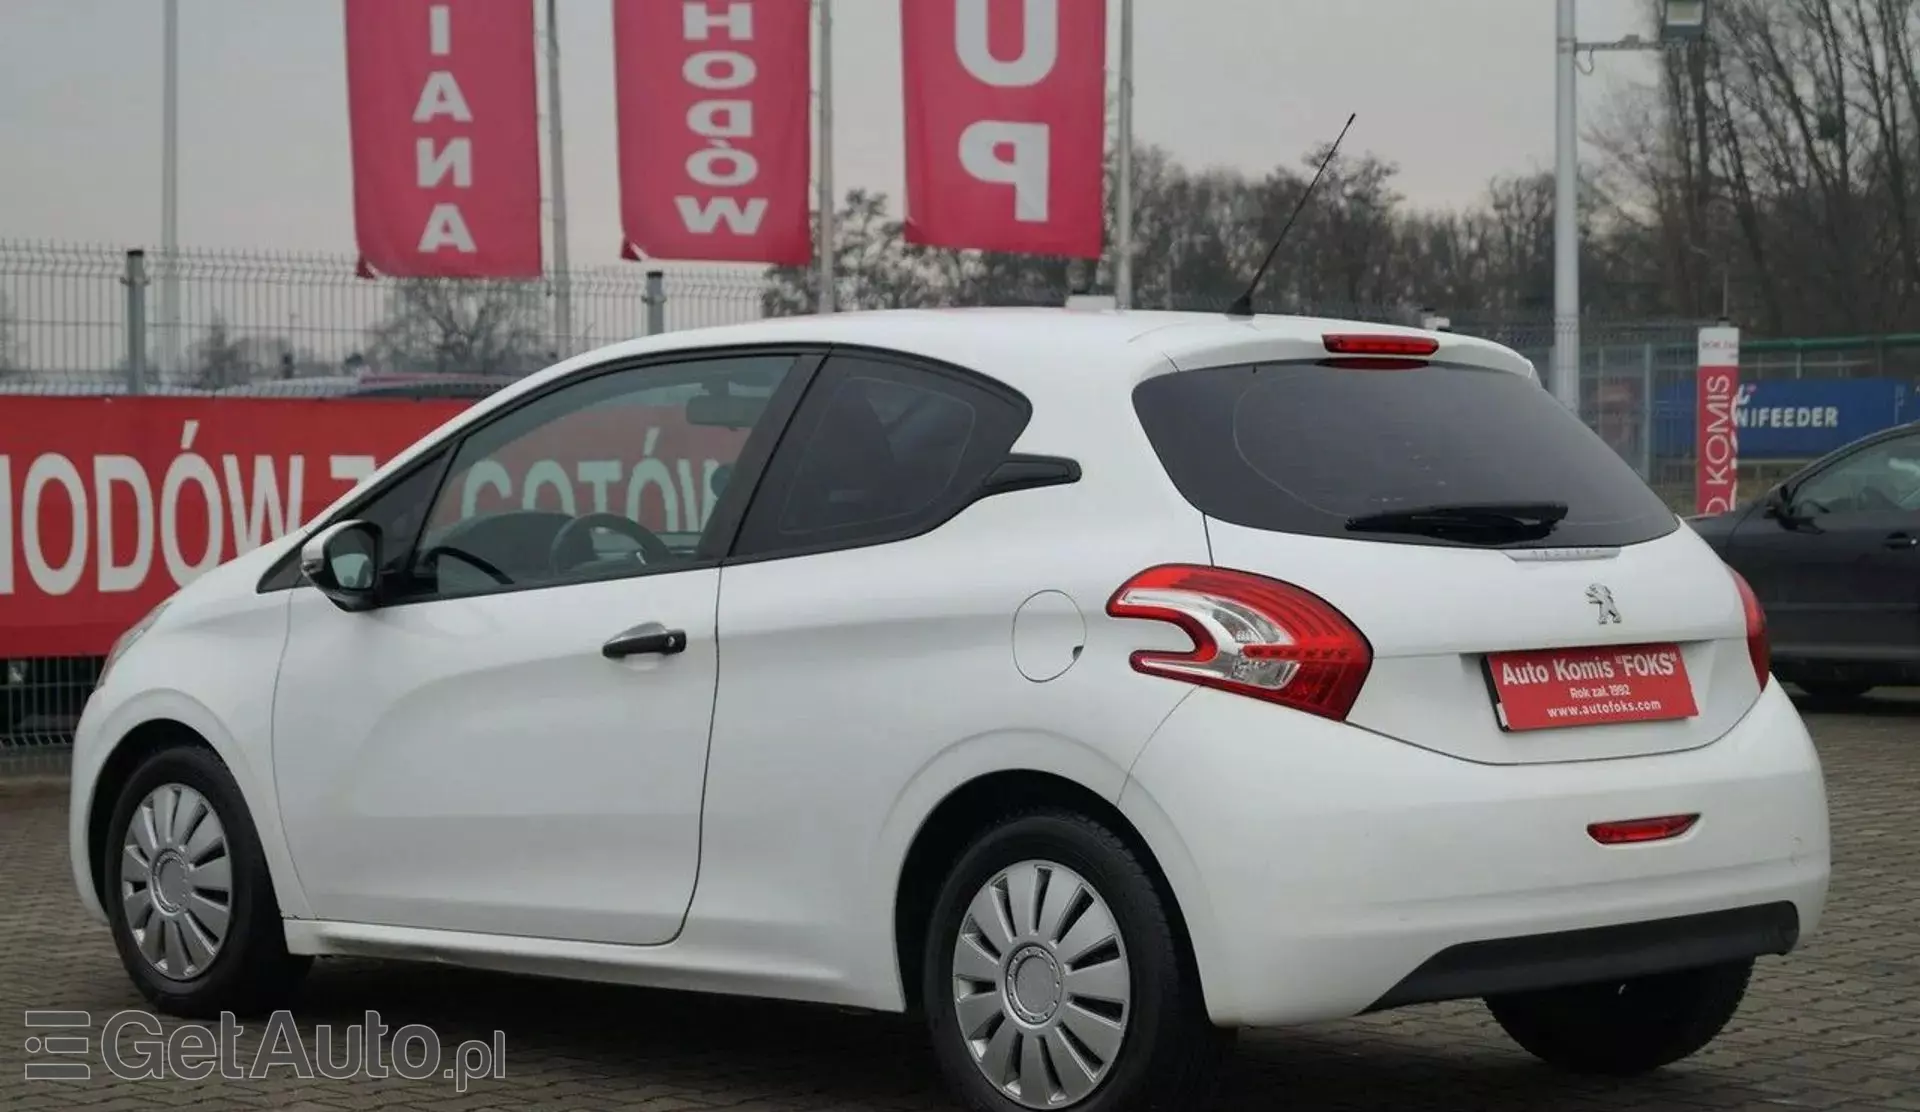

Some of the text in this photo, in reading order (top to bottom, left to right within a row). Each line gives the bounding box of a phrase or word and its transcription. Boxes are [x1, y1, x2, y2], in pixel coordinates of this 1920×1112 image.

[1706, 375, 1730, 485] KOMIS
[0, 420, 305, 596] ODÓW
[1503, 662, 1549, 685] Auto
[1553, 657, 1615, 681] Komis
[1570, 687, 1590, 700] Rok
[1547, 700, 1662, 718] www.autofoks.com
